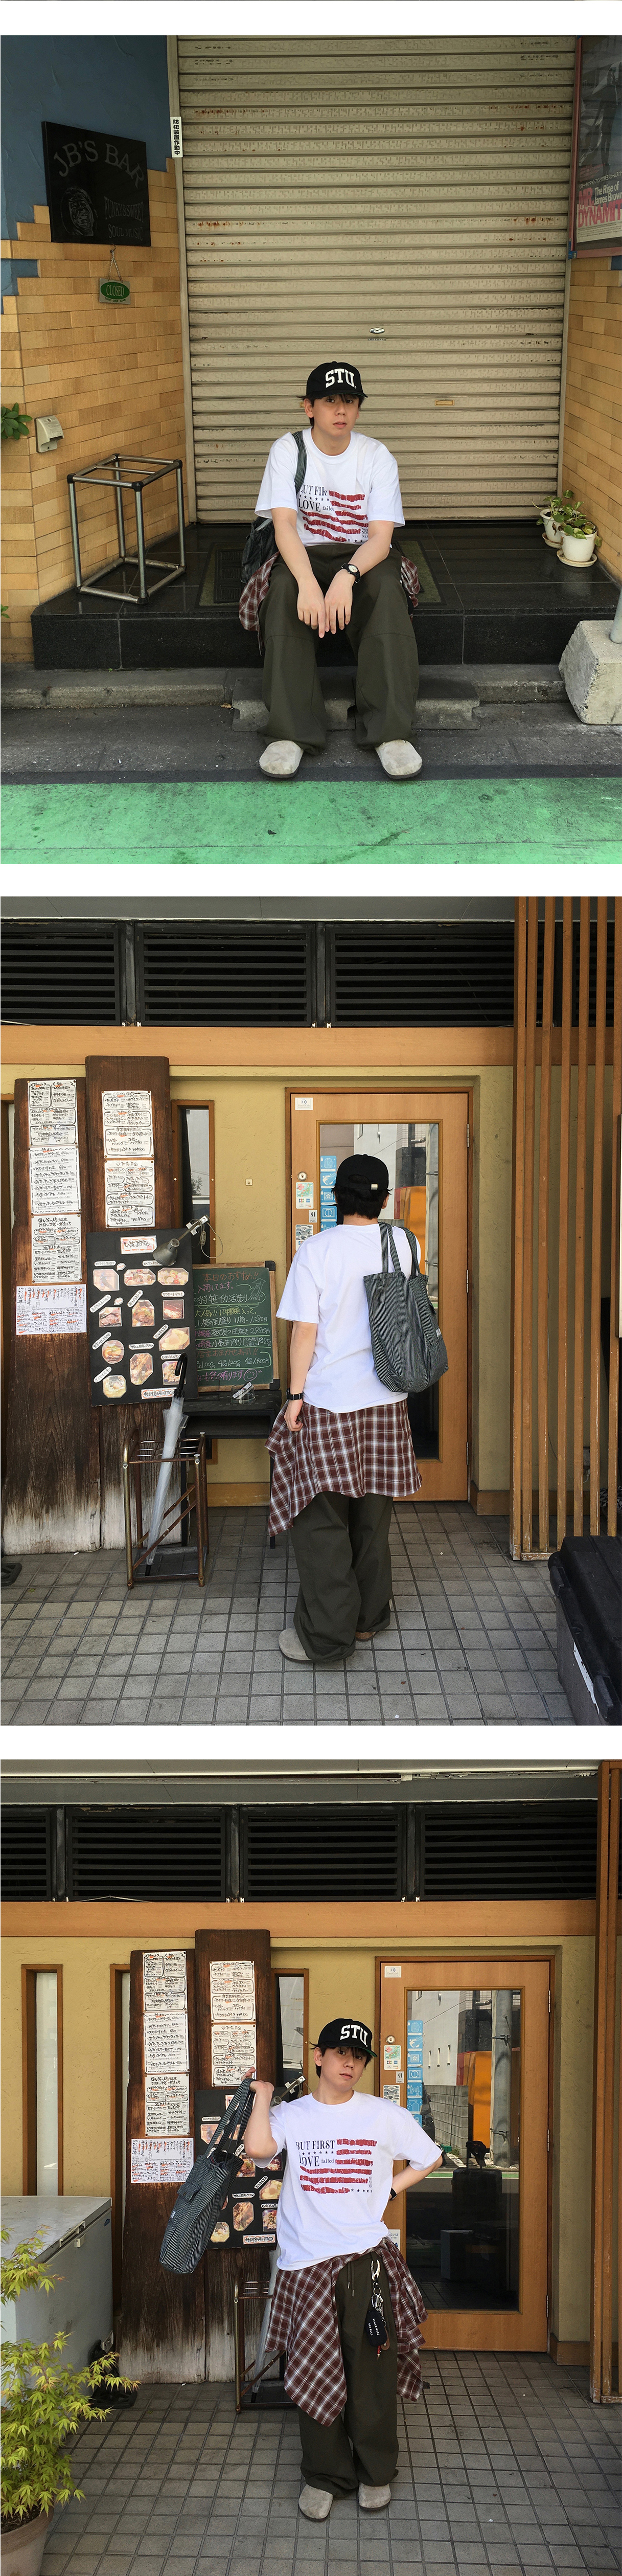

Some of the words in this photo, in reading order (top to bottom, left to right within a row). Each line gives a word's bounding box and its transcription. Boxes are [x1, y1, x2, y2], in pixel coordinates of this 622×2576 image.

[53, 140, 99, 177] JB'S
[104, 143, 144, 189] BAR
[594, 186, 603, 195] The
[603, 184, 614, 195] Rise
[614, 180, 620, 192] of
[594, 193, 608, 206] James
[104, 196, 144, 223] FUNKY&SWEET
[108, 224, 125, 239] SOUL
[125, 227, 144, 241] MUSIC
[106, 284, 125, 297] CLOSED
[298, 498, 321, 512] LOVE
[197, 1281, 234, 1293] 入荷してます。
[295, 2141, 310, 2151] BUT
[312, 2140, 335, 2150] FIRST
[299, 2154, 320, 2167] LOVE
